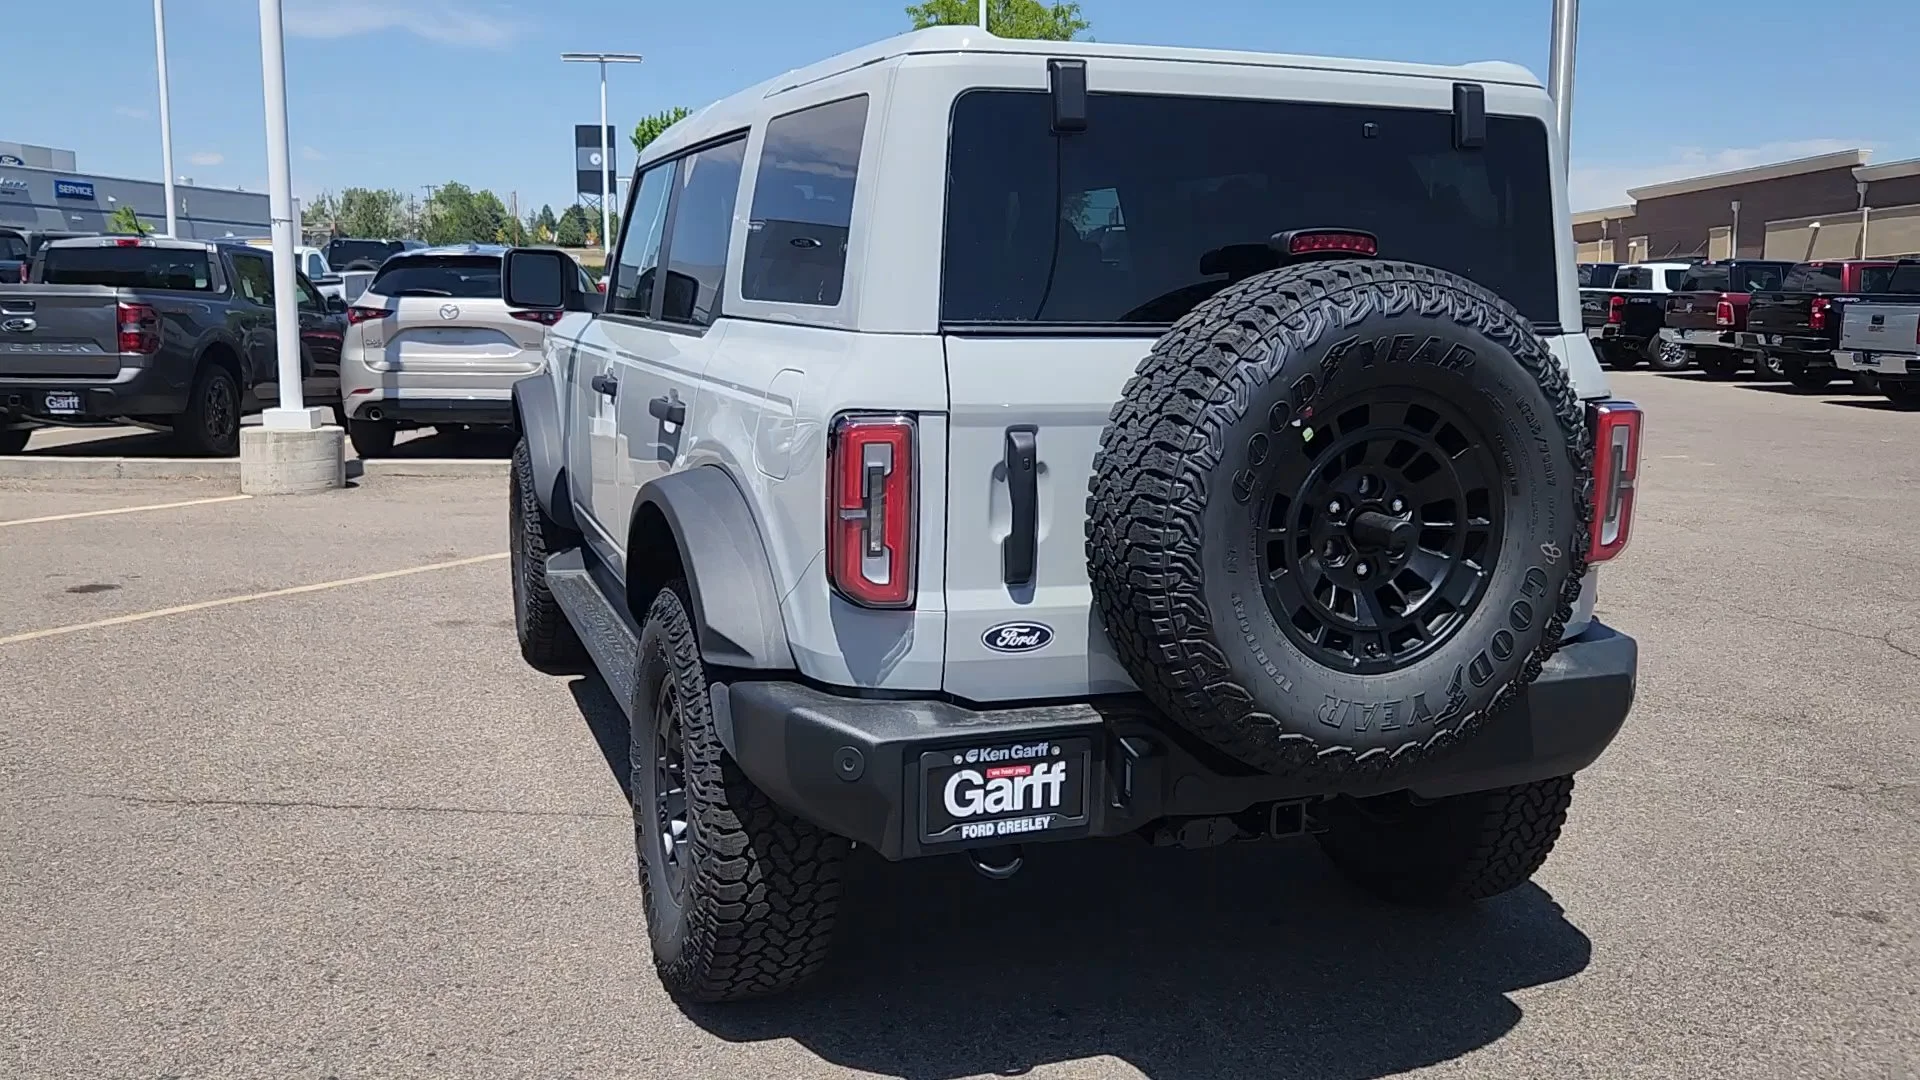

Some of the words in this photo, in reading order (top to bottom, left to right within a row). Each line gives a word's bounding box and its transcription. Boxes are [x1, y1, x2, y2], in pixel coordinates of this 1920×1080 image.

[58, 184, 93, 196] SERVICE
[45, 396, 80, 408] Garff
[996, 627, 1041, 647] Ford
[1317, 565, 1549, 732] GOODYEAR
[980, 747, 1009, 762] Ken
[1010, 742, 1049, 759] Garff
[944, 761, 1066, 817] Garff
[961, 823, 995, 839] FORD
[997, 816, 1050, 835] GREELEY
